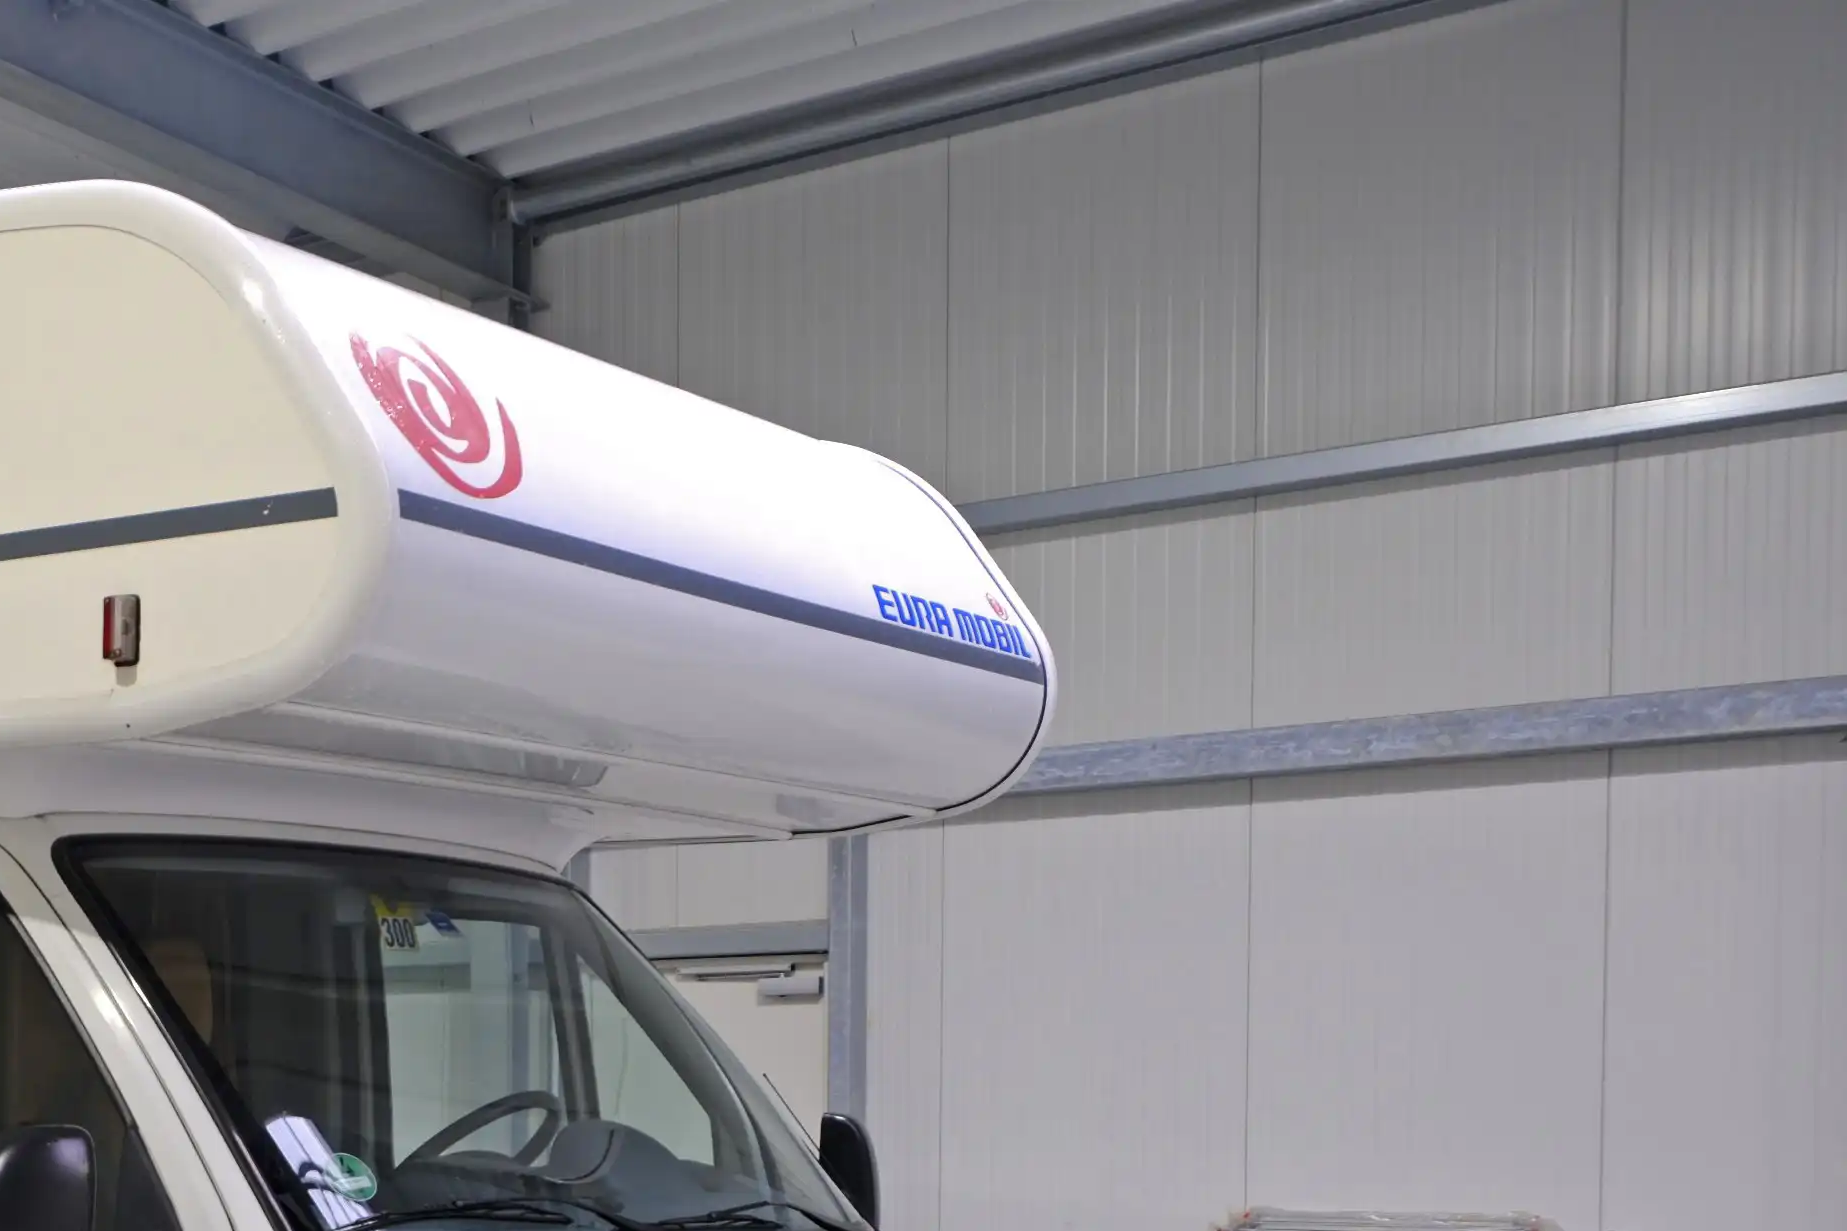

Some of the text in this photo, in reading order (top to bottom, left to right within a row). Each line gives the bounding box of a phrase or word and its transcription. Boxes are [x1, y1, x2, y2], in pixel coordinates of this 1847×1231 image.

[872, 584, 1031, 659] EURA MOBIL
[381, 918, 416, 948] 300
